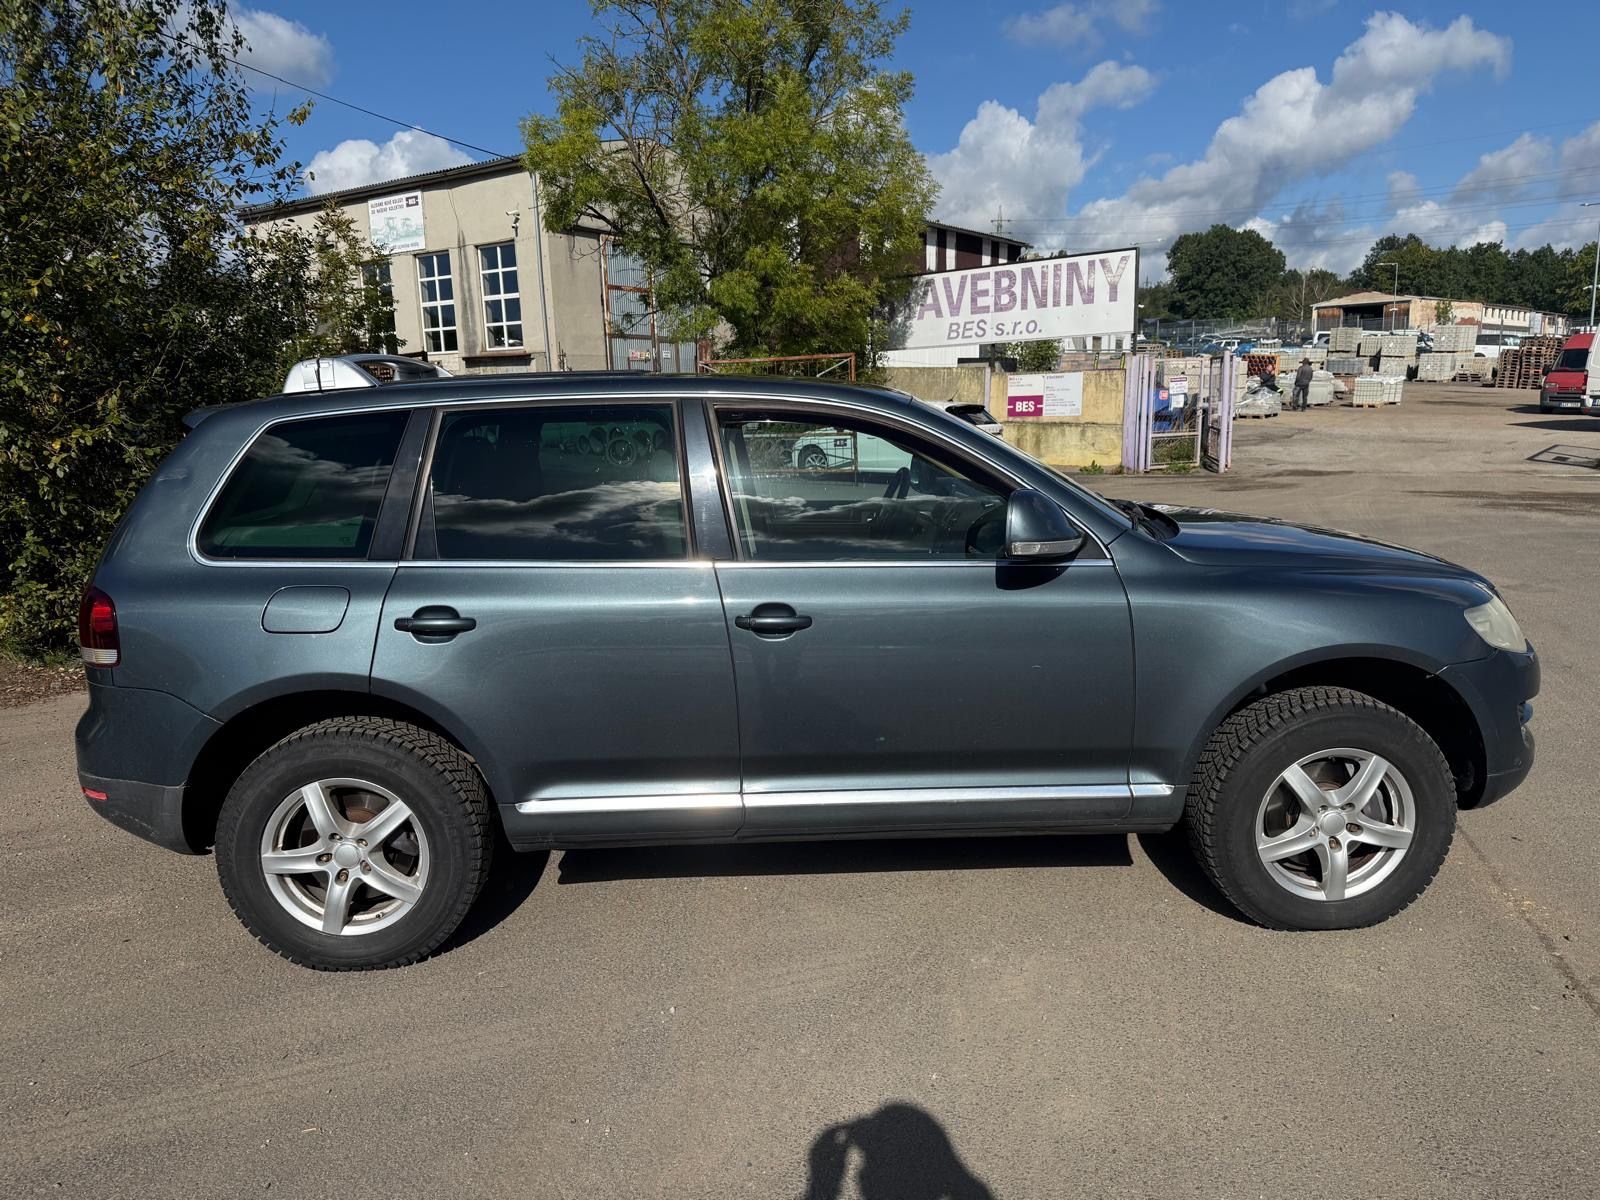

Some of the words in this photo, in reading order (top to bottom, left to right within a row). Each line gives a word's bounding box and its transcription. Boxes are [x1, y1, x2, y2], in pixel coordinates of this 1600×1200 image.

[902, 255, 1131, 321] AVEBNINY
[947, 319, 987, 341] BES
[994, 319, 1043, 337] s.r.o.
[1015, 400, 1036, 413] BES
